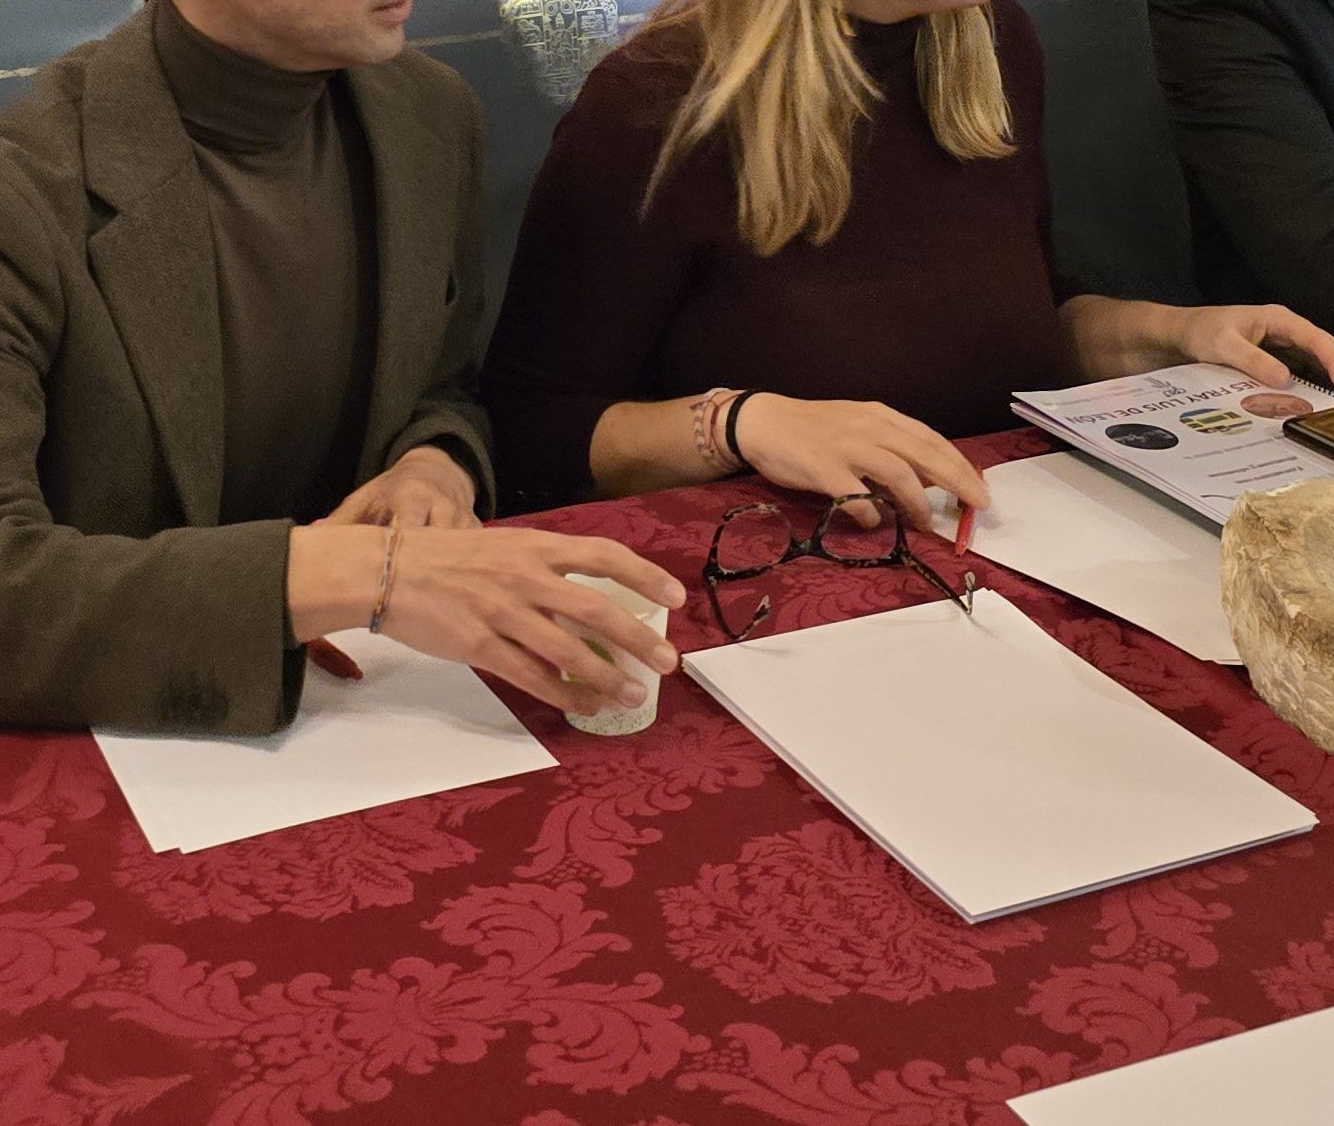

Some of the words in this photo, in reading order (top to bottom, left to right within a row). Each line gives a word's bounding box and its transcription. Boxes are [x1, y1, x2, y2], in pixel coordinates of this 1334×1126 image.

[1229, 380, 1264, 394] IES
[1188, 386, 1229, 405] FRAY
[1142, 395, 1187, 413] LUIS
[1065, 411, 1116, 425] LEÓN
[1117, 406, 1141, 418] DE
